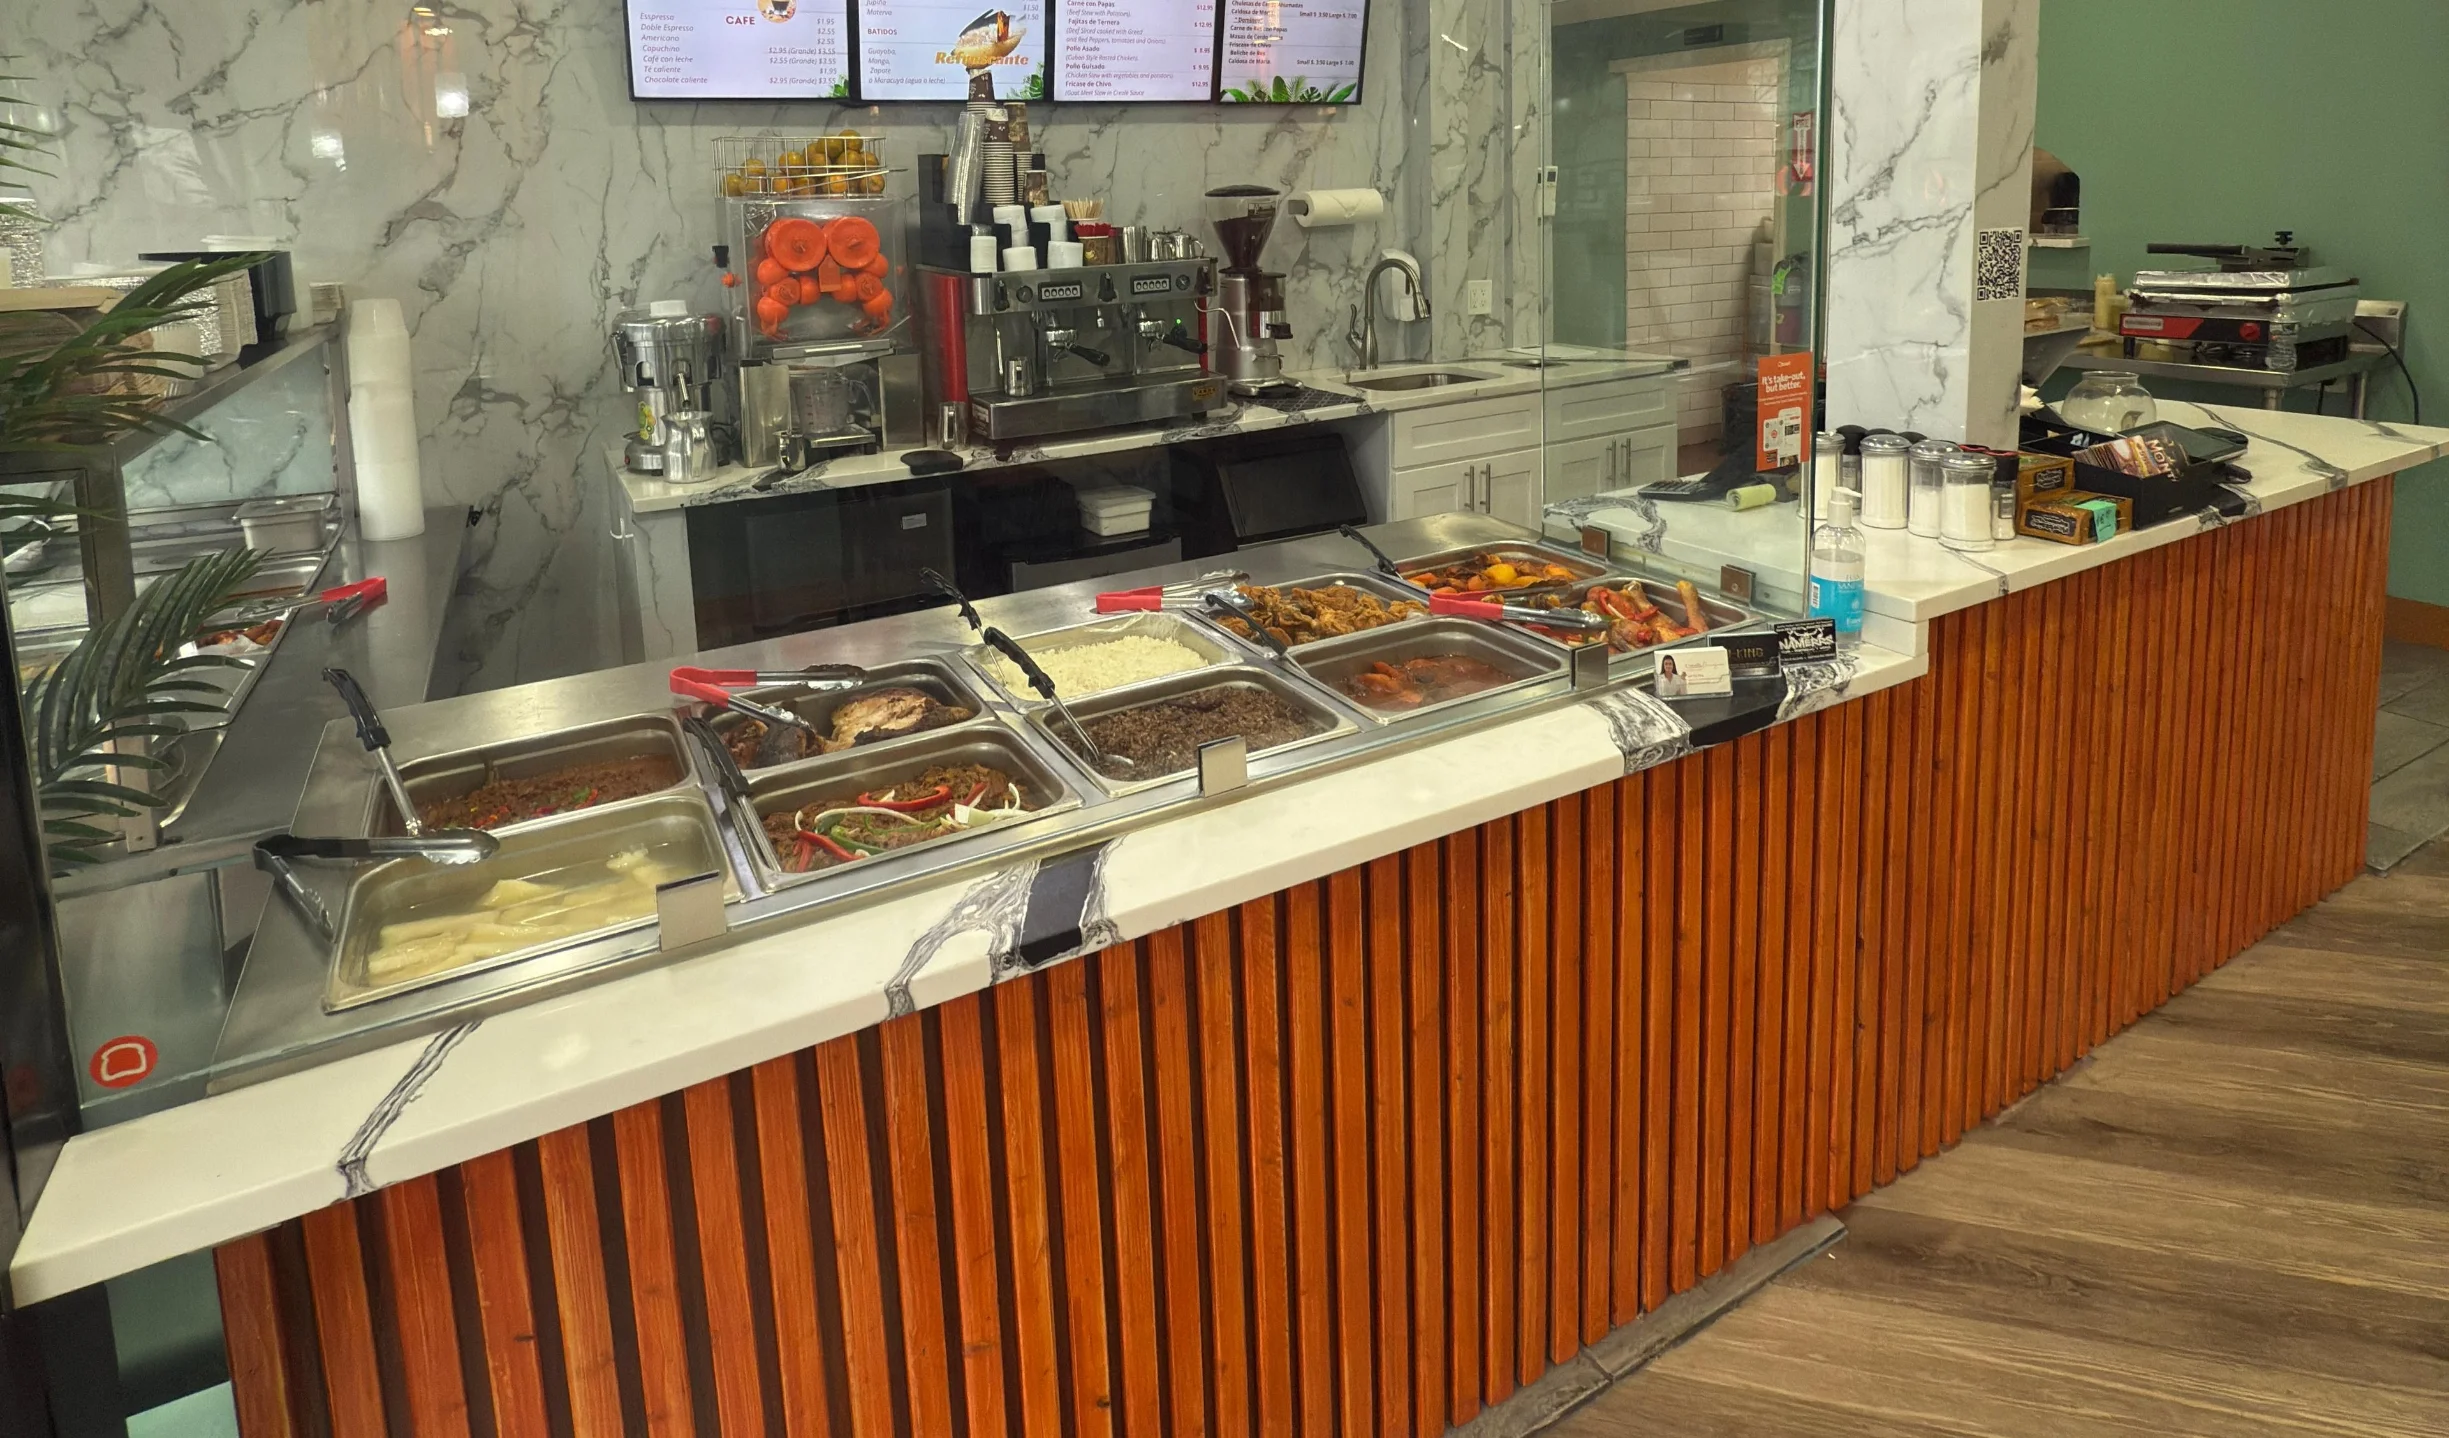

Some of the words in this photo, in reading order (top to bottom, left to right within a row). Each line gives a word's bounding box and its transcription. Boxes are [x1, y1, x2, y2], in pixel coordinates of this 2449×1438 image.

[725, 16, 756, 24] CAFE
[642, 44, 680, 52] Capuchino
[870, 67, 892, 75] Zapote
[788, 77, 817, 85] (Grande)
[1766, 383, 1778, 393] but
